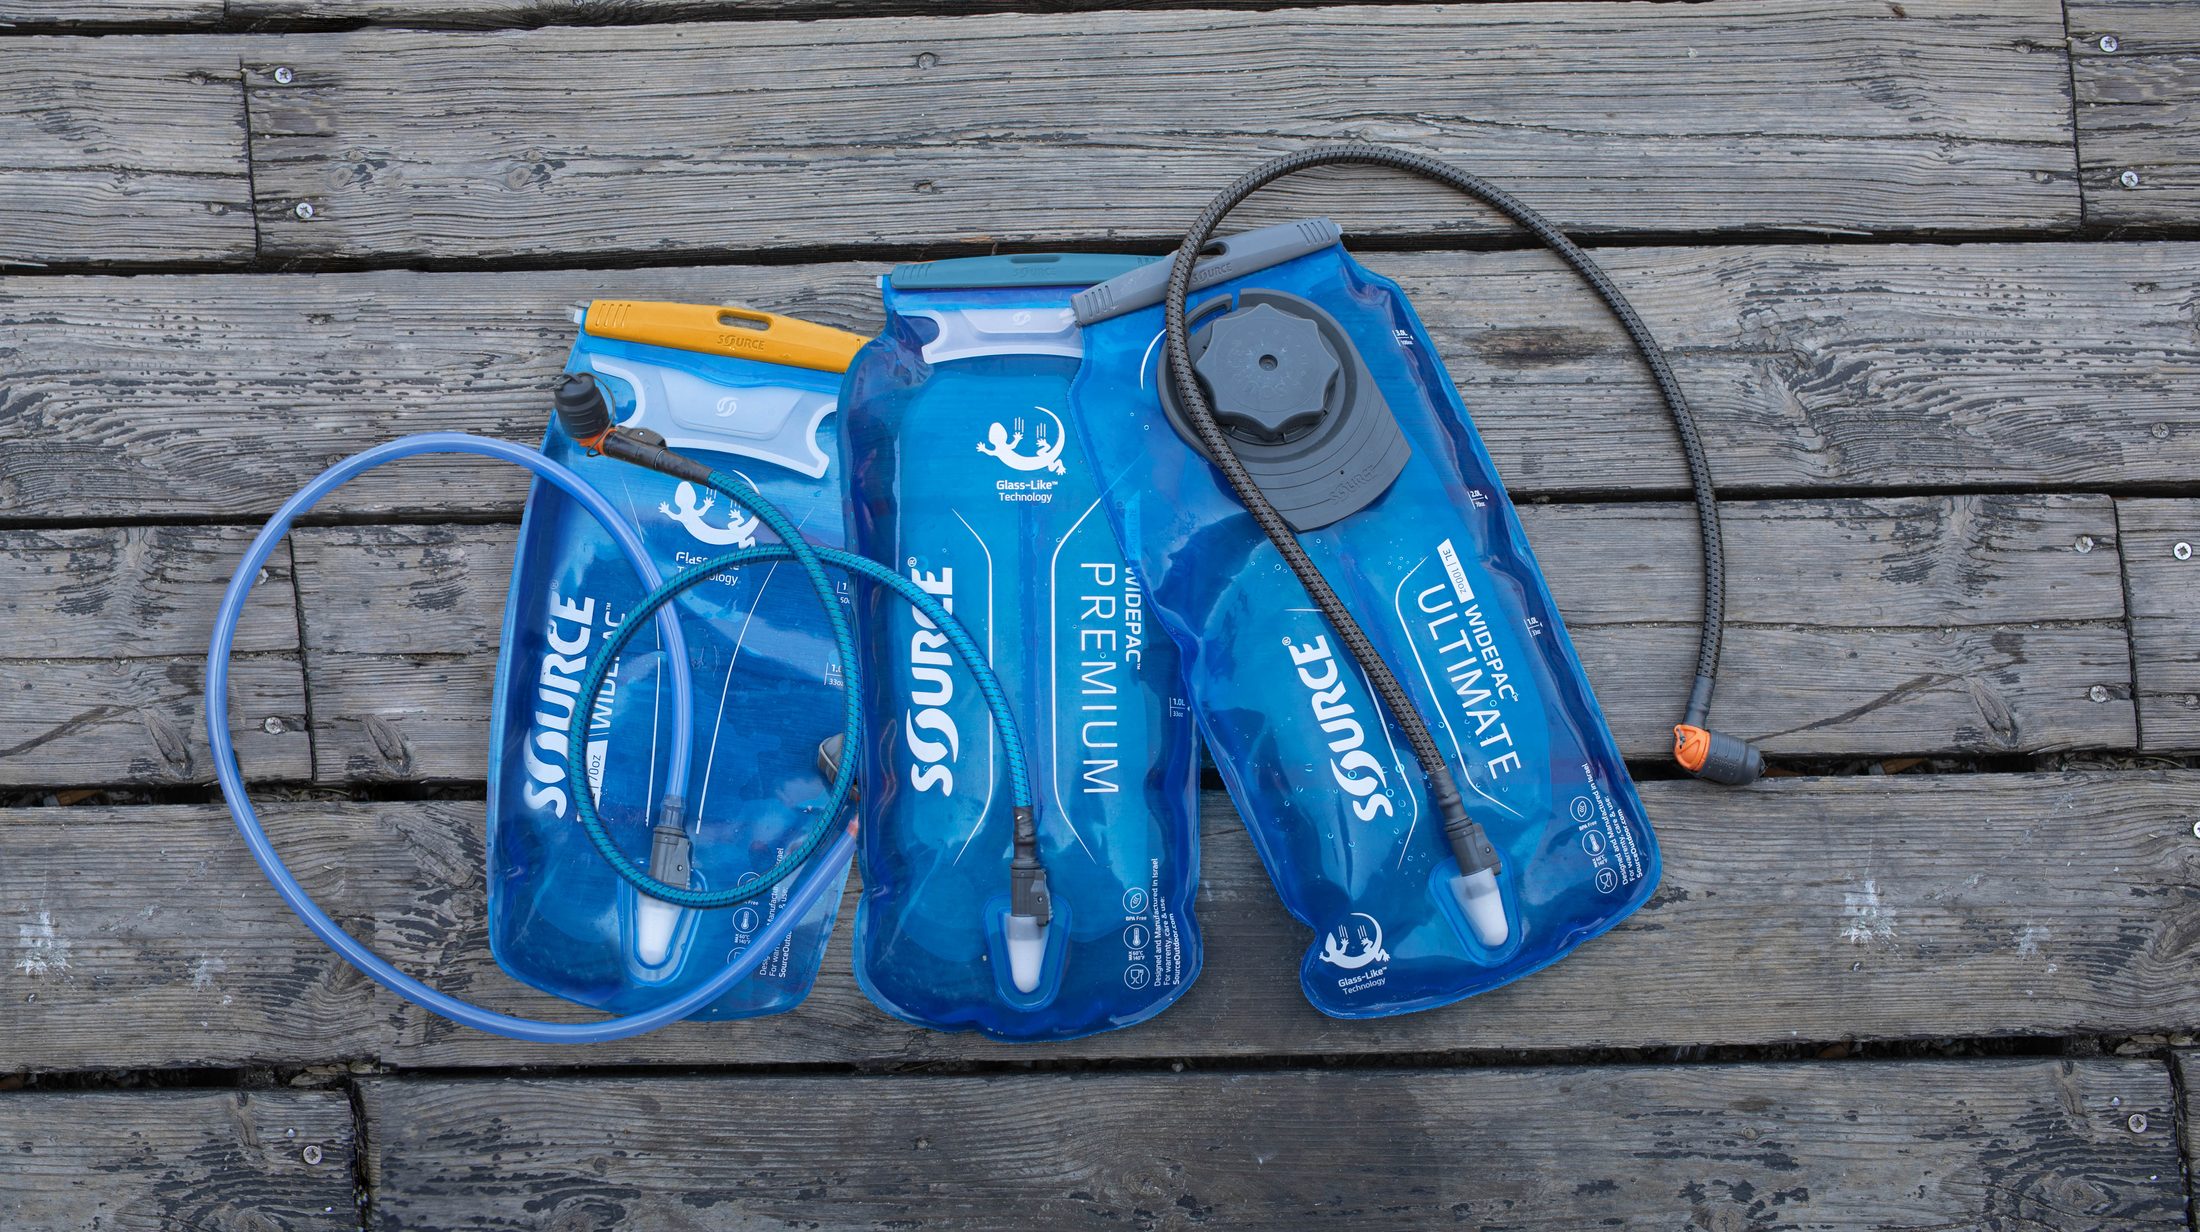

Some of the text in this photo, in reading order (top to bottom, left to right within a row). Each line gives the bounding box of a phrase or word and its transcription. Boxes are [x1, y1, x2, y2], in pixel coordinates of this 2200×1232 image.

[1192, 262, 1233, 283] SOURCE
[716, 334, 765, 352] SOURCE
[999, 492, 1052, 504] Technology
[677, 566, 738, 587] Tology
[1442, 548, 1467, 595] 3L 100oz
[1080, 562, 1119, 794] PREMIUM
[1417, 583, 1522, 781] ULTIMATE
[1582, 763, 1594, 783] Israel
[1592, 791, 1615, 839] Manufactured
[1610, 839, 1620, 852] and
[1617, 809, 1643, 878] SourceOutdoor.com
[1151, 858, 1159, 878] Israel
[1615, 853, 1629, 885] Designed
[1151, 879, 1158, 887] in
[1152, 888, 1162, 939] Manufactured
[1163, 920, 1171, 937] care
[1168, 913, 1181, 985] SourceOutdoor.com
[1154, 955, 1163, 987] Designed
[1163, 973, 1171, 986] For
[1342, 977, 1386, 995] Technology
